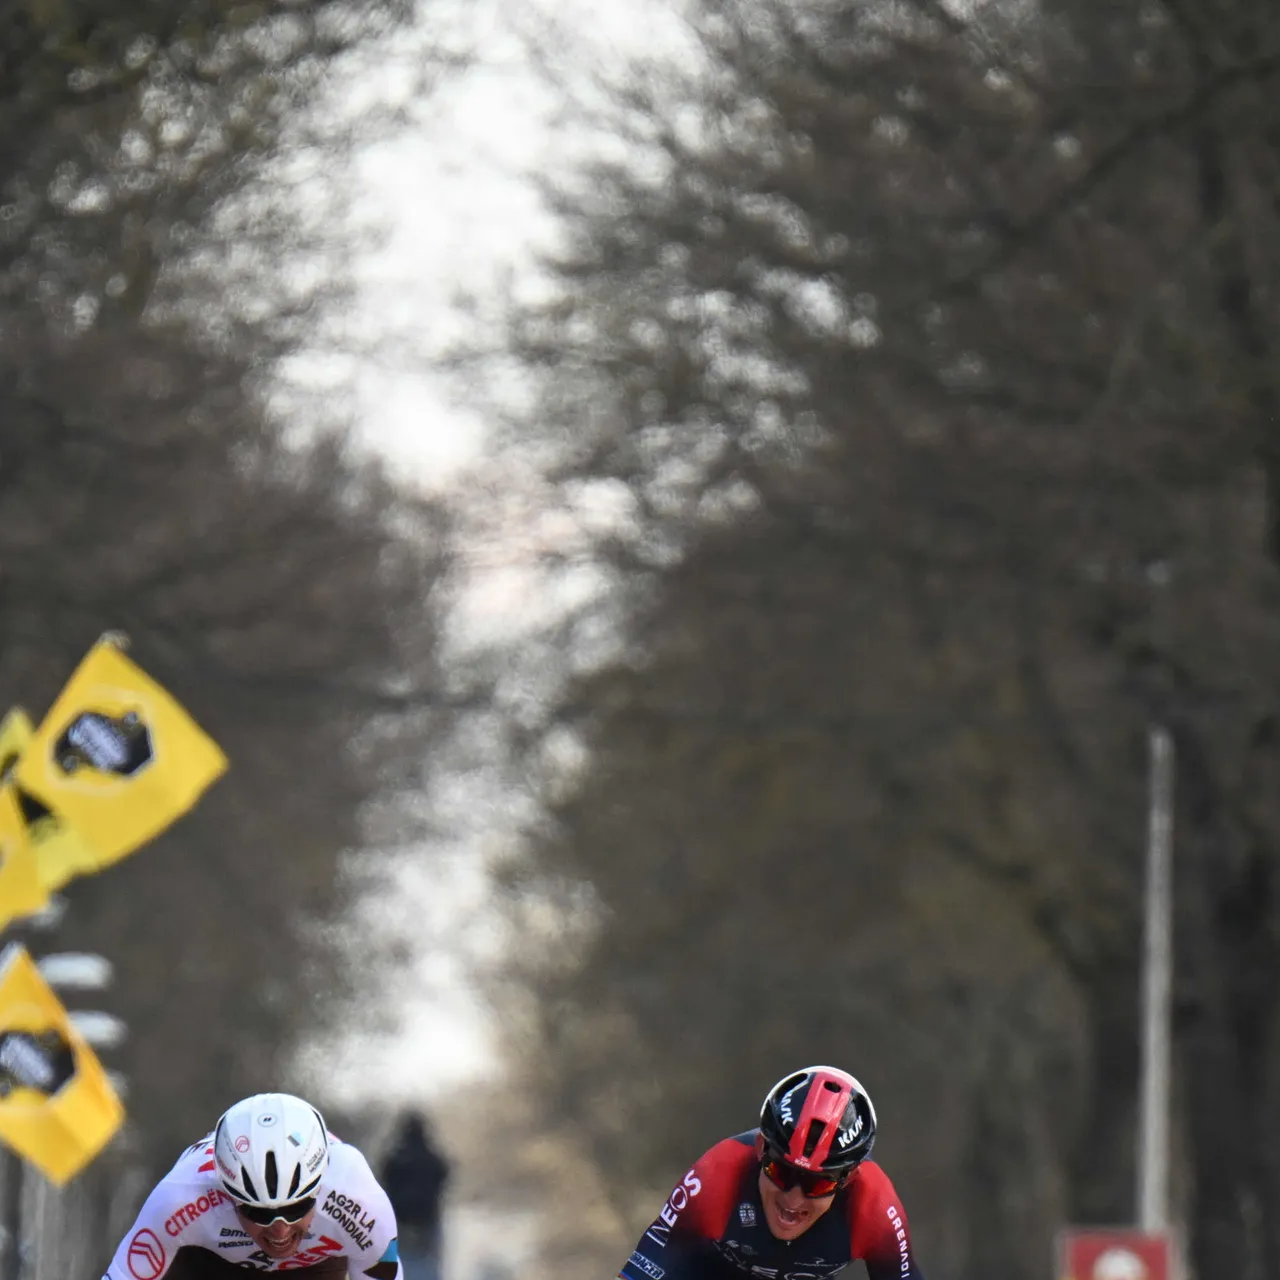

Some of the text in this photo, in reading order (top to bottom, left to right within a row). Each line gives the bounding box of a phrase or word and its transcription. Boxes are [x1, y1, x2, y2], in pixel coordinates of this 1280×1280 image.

[322, 1202, 373, 1252] MONDIALE
[327, 1190, 376, 1232] AG2R LA
[646, 1169, 701, 1249] INEOS
